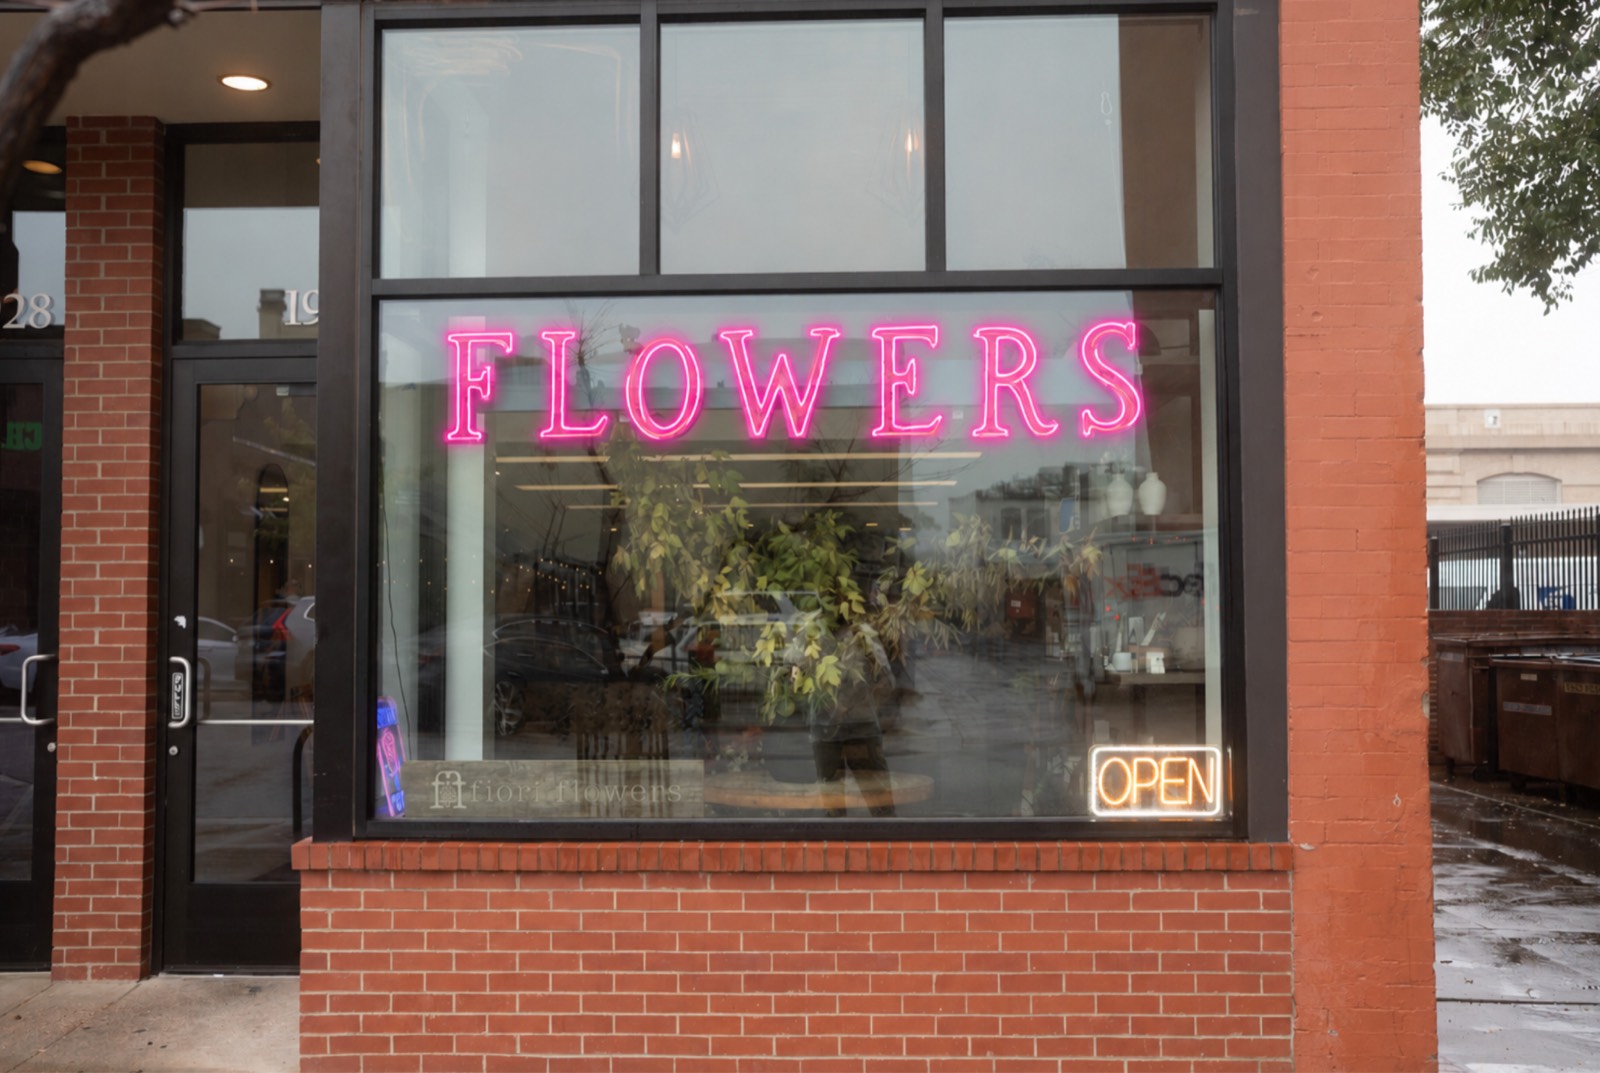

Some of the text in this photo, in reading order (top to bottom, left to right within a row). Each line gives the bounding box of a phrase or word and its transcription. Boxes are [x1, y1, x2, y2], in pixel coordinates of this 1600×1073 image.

[0, 293, 52, 329] 28
[447, 322, 1141, 440] FLOWERS
[470, 779, 540, 801] fiori
[558, 779, 682, 802] flowers
[1098, 757, 1214, 805] OPEN
